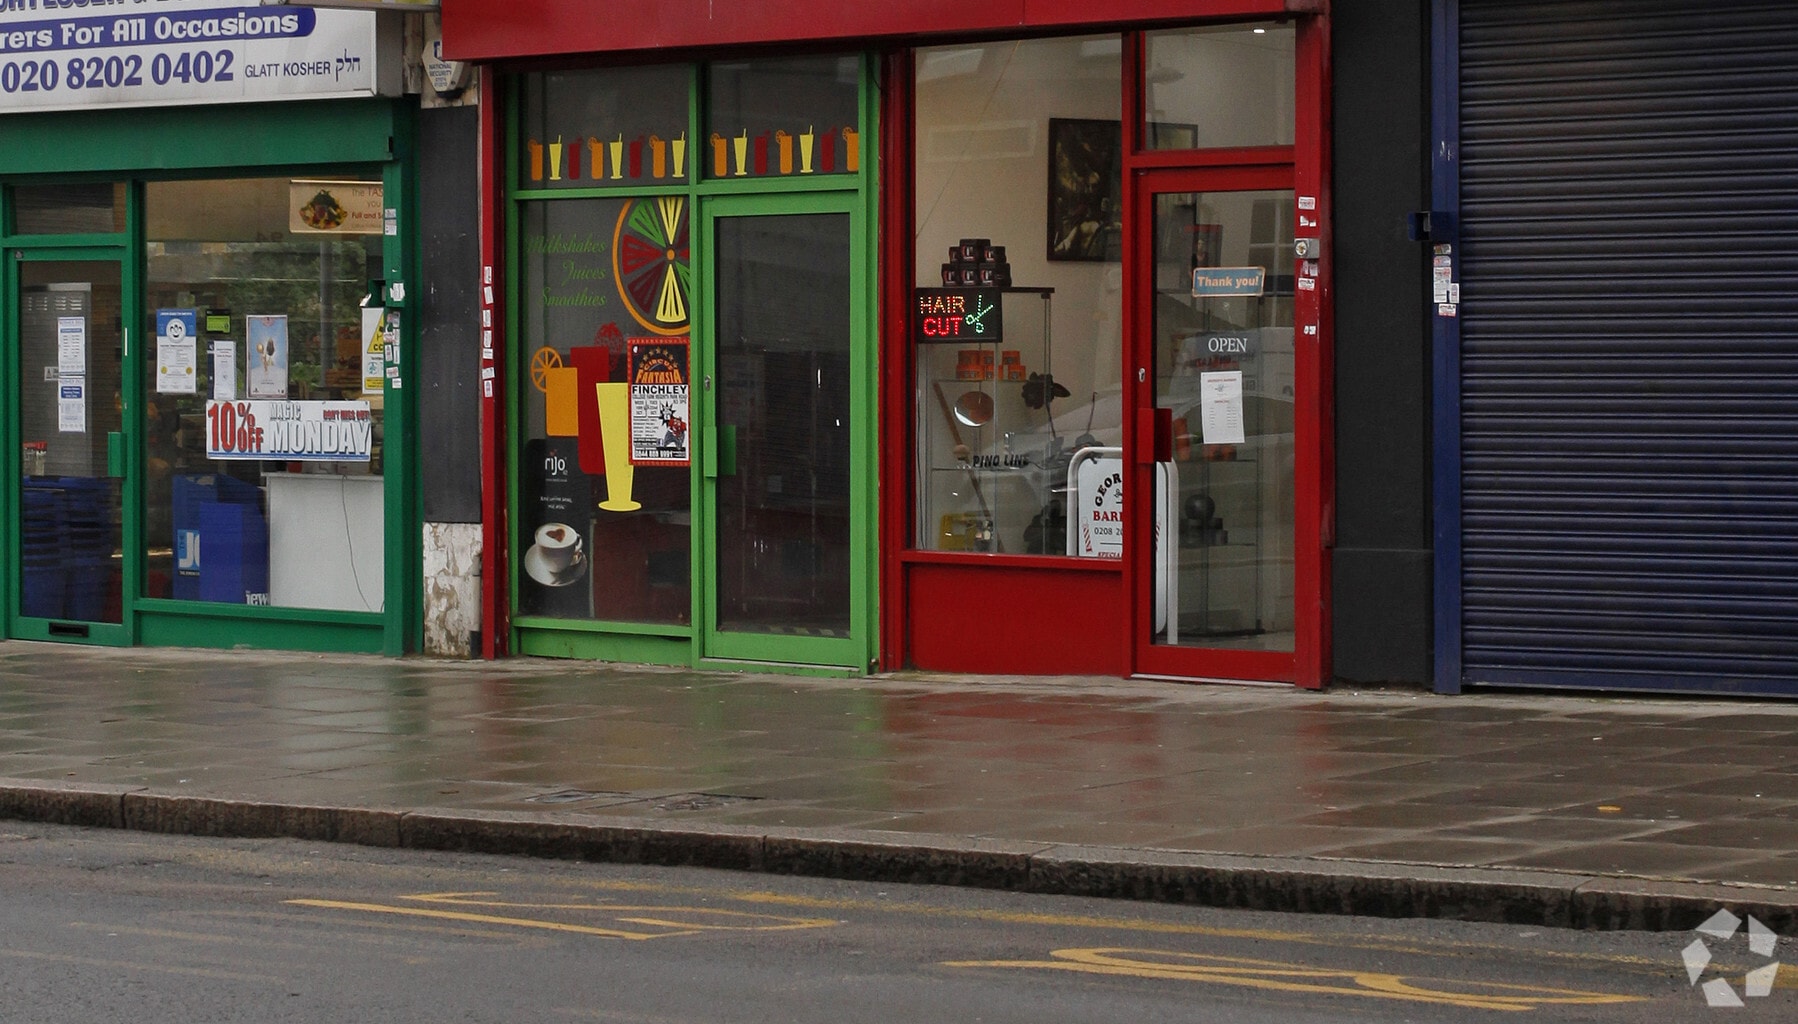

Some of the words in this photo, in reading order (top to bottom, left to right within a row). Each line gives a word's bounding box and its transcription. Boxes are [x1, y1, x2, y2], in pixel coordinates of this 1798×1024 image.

[60, 23, 104, 46] For
[112, 18, 146, 42] All
[154, 12, 299, 40] Occasions
[1, 60, 59, 93] 020
[66, 54, 143, 89] 8202
[151, 49, 234, 85] 0402
[245, 63, 279, 77] GLATT
[283, 61, 330, 76] KOSHER
[1197, 275, 1233, 287] Thank
[1235, 275, 1259, 289] you!
[920, 296, 965, 314] HAIR
[923, 316, 963, 336] CUT
[1208, 338, 1247, 352] OPEN
[635, 367, 683, 384] FANTASIA
[632, 385, 687, 395] FINCHLEY
[207, 402, 256, 452] 10%
[237, 427, 263, 452] OFF
[268, 420, 371, 454] MONDAY
[1094, 527, 1113, 535] 0208
